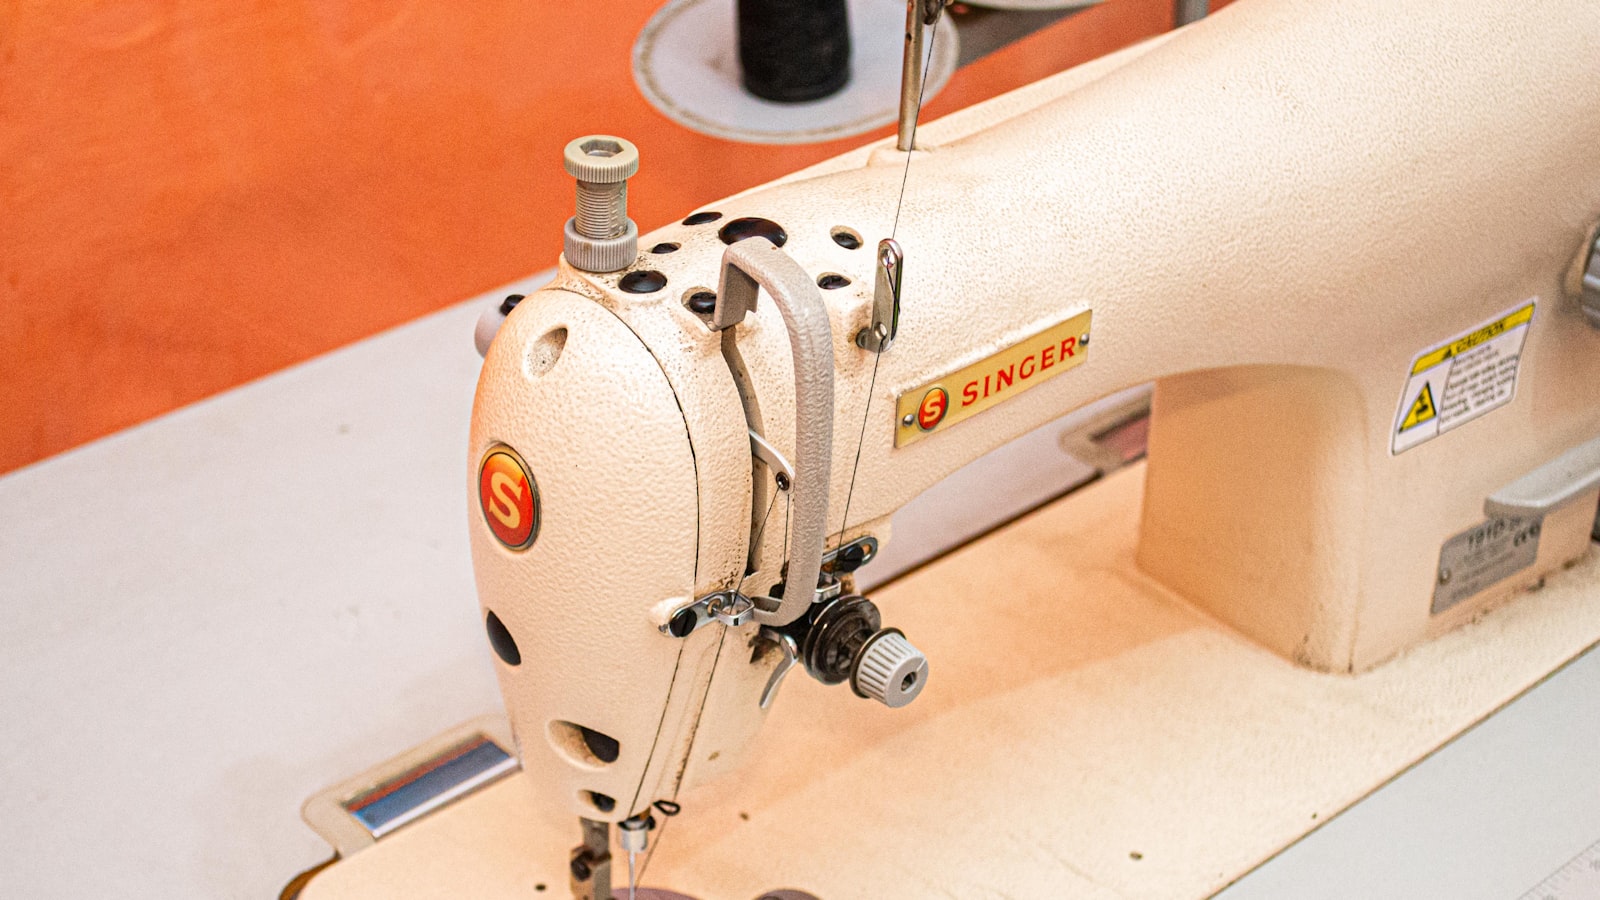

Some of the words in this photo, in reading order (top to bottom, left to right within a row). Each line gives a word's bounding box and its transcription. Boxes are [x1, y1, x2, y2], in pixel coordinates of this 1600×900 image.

[922, 394, 942, 424] S
[961, 336, 1077, 407] SINGER
[489, 471, 522, 529] S
